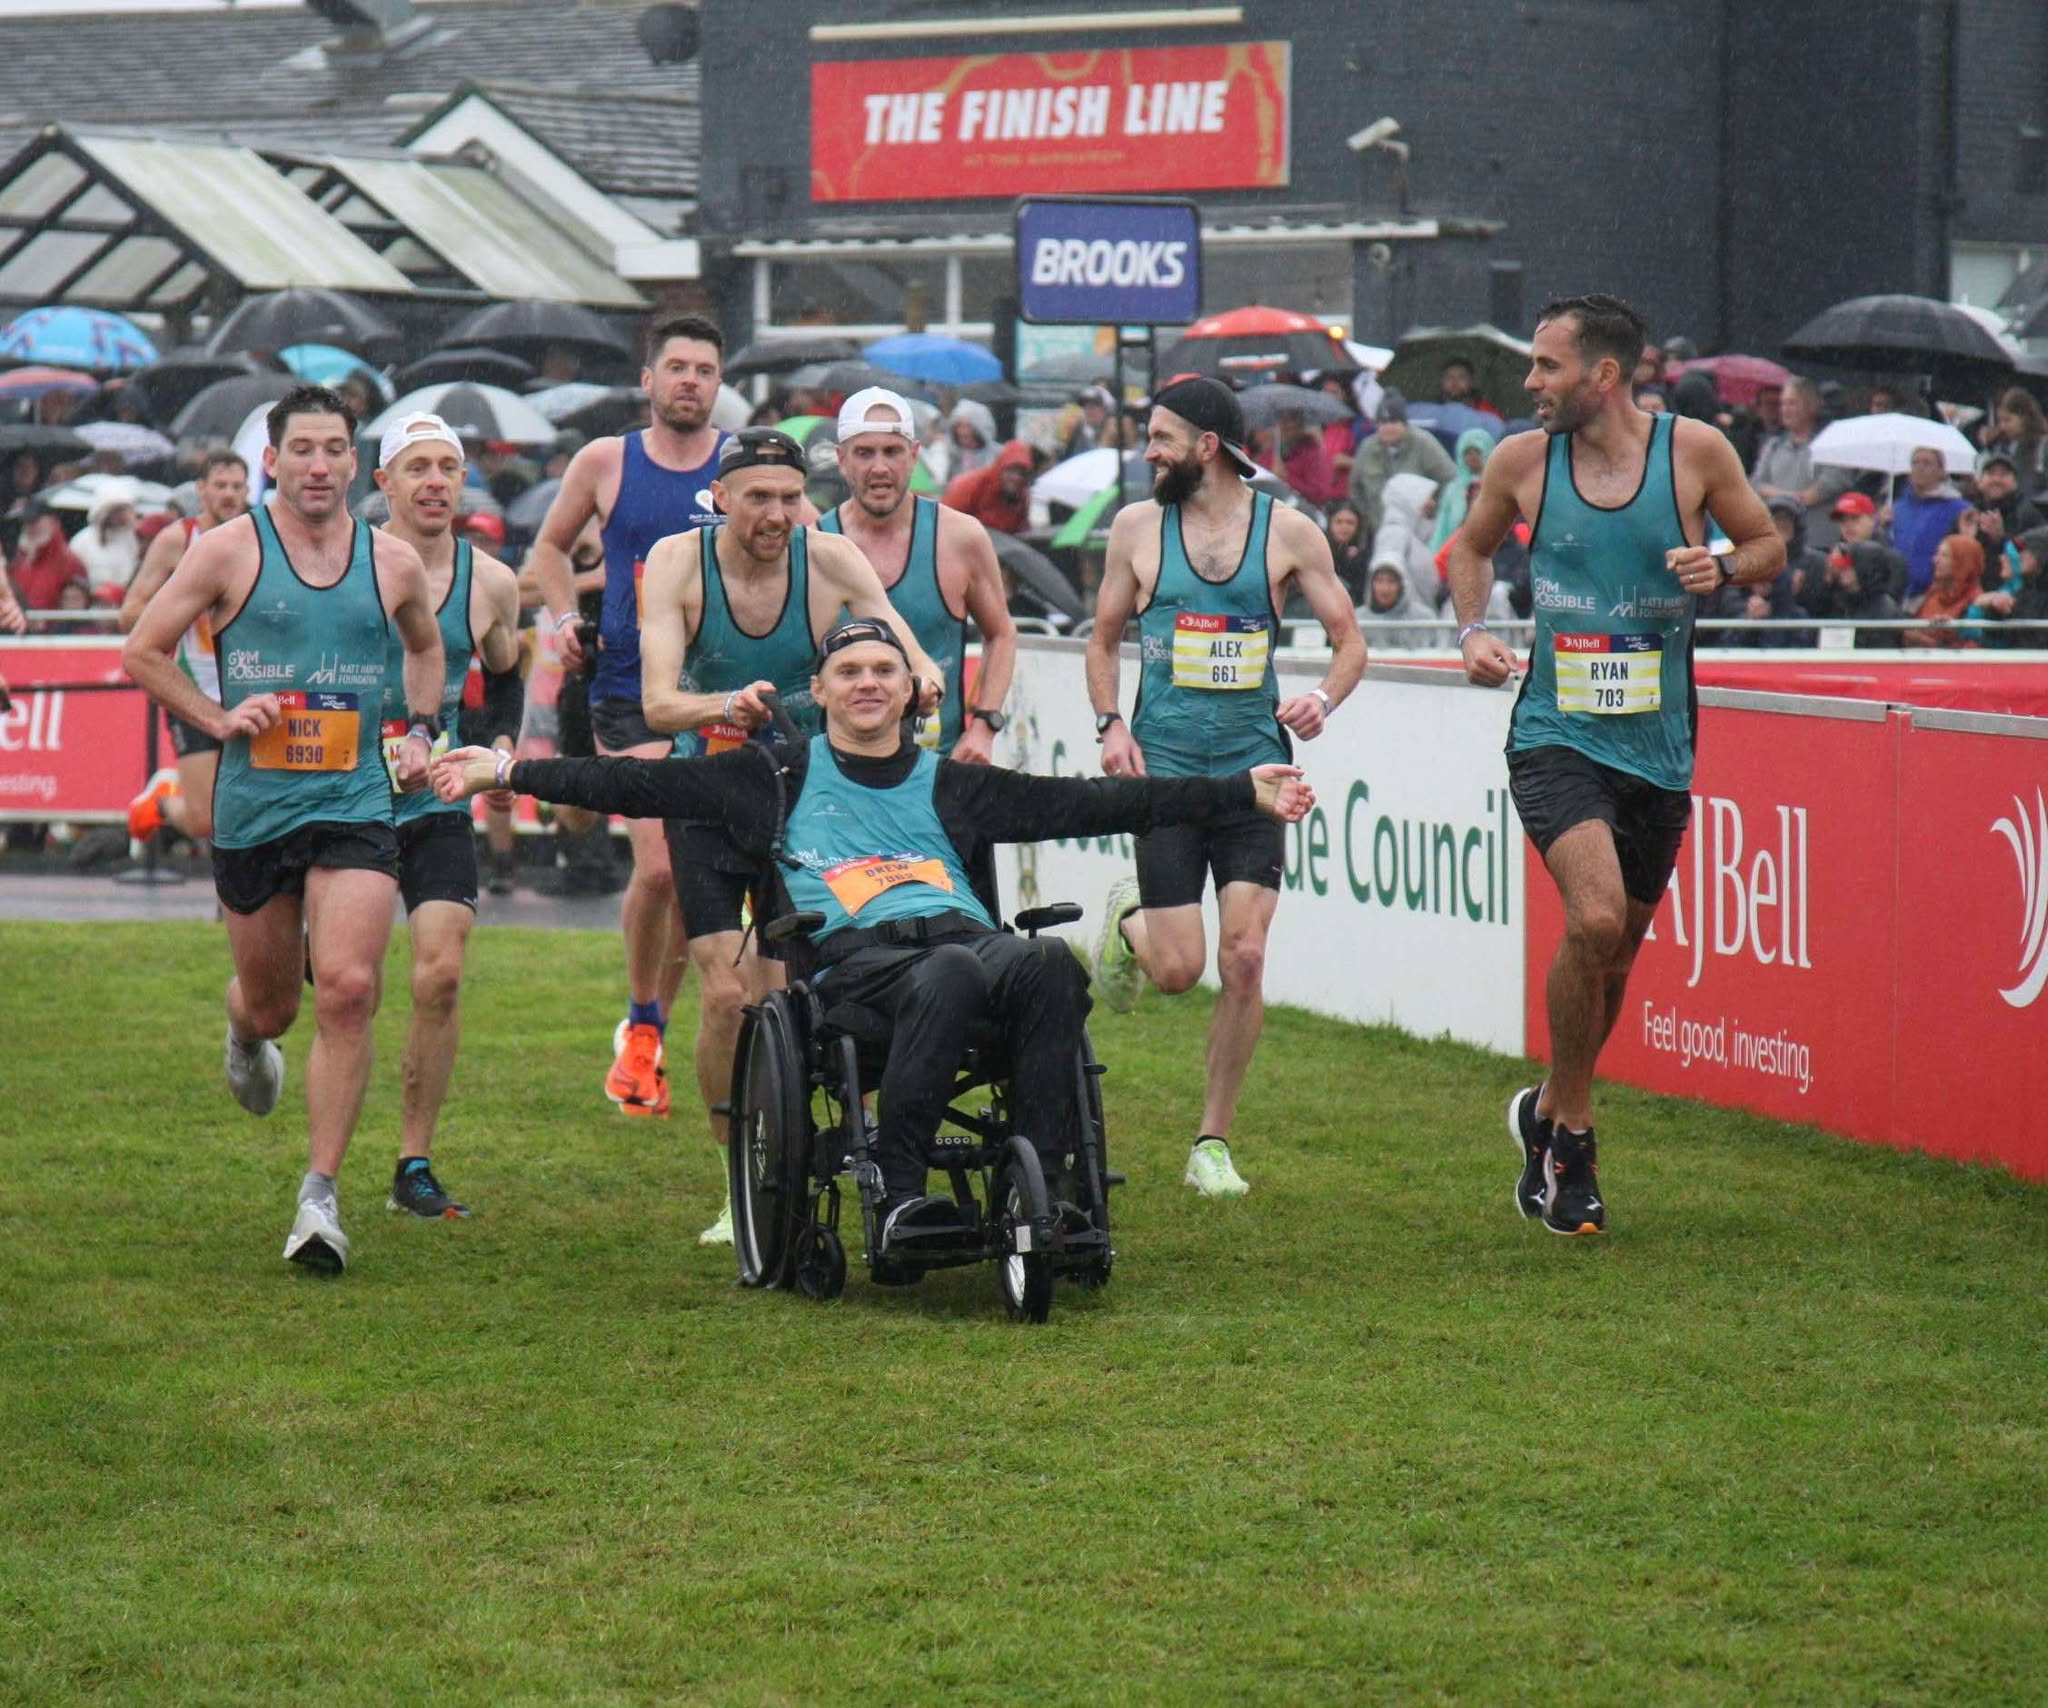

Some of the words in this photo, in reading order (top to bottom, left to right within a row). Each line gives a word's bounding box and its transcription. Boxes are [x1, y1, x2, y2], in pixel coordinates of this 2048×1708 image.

[864, 92, 946, 145] THE
[957, 85, 1110, 142] FINISH
[1123, 80, 1230, 138] LINE
[1031, 237, 1188, 288] BROOKS
[228, 649, 260, 666] GYM
[1209, 640, 1243, 658] ALEX
[228, 663, 296, 680] POSSIBLE
[1212, 665, 1238, 683] 661
[1590, 661, 1629, 681] RYAN
[1595, 689, 1625, 708] 703
[288, 719, 321, 737] NICK
[286, 744, 324, 763] 6930
[1344, 779, 1510, 925] Council
[864, 862, 910, 878] DREW
[1643, 1000, 1677, 1052] Feel
[1680, 1016, 1730, 1069] good,
[1733, 1018, 1815, 1095] investing.
